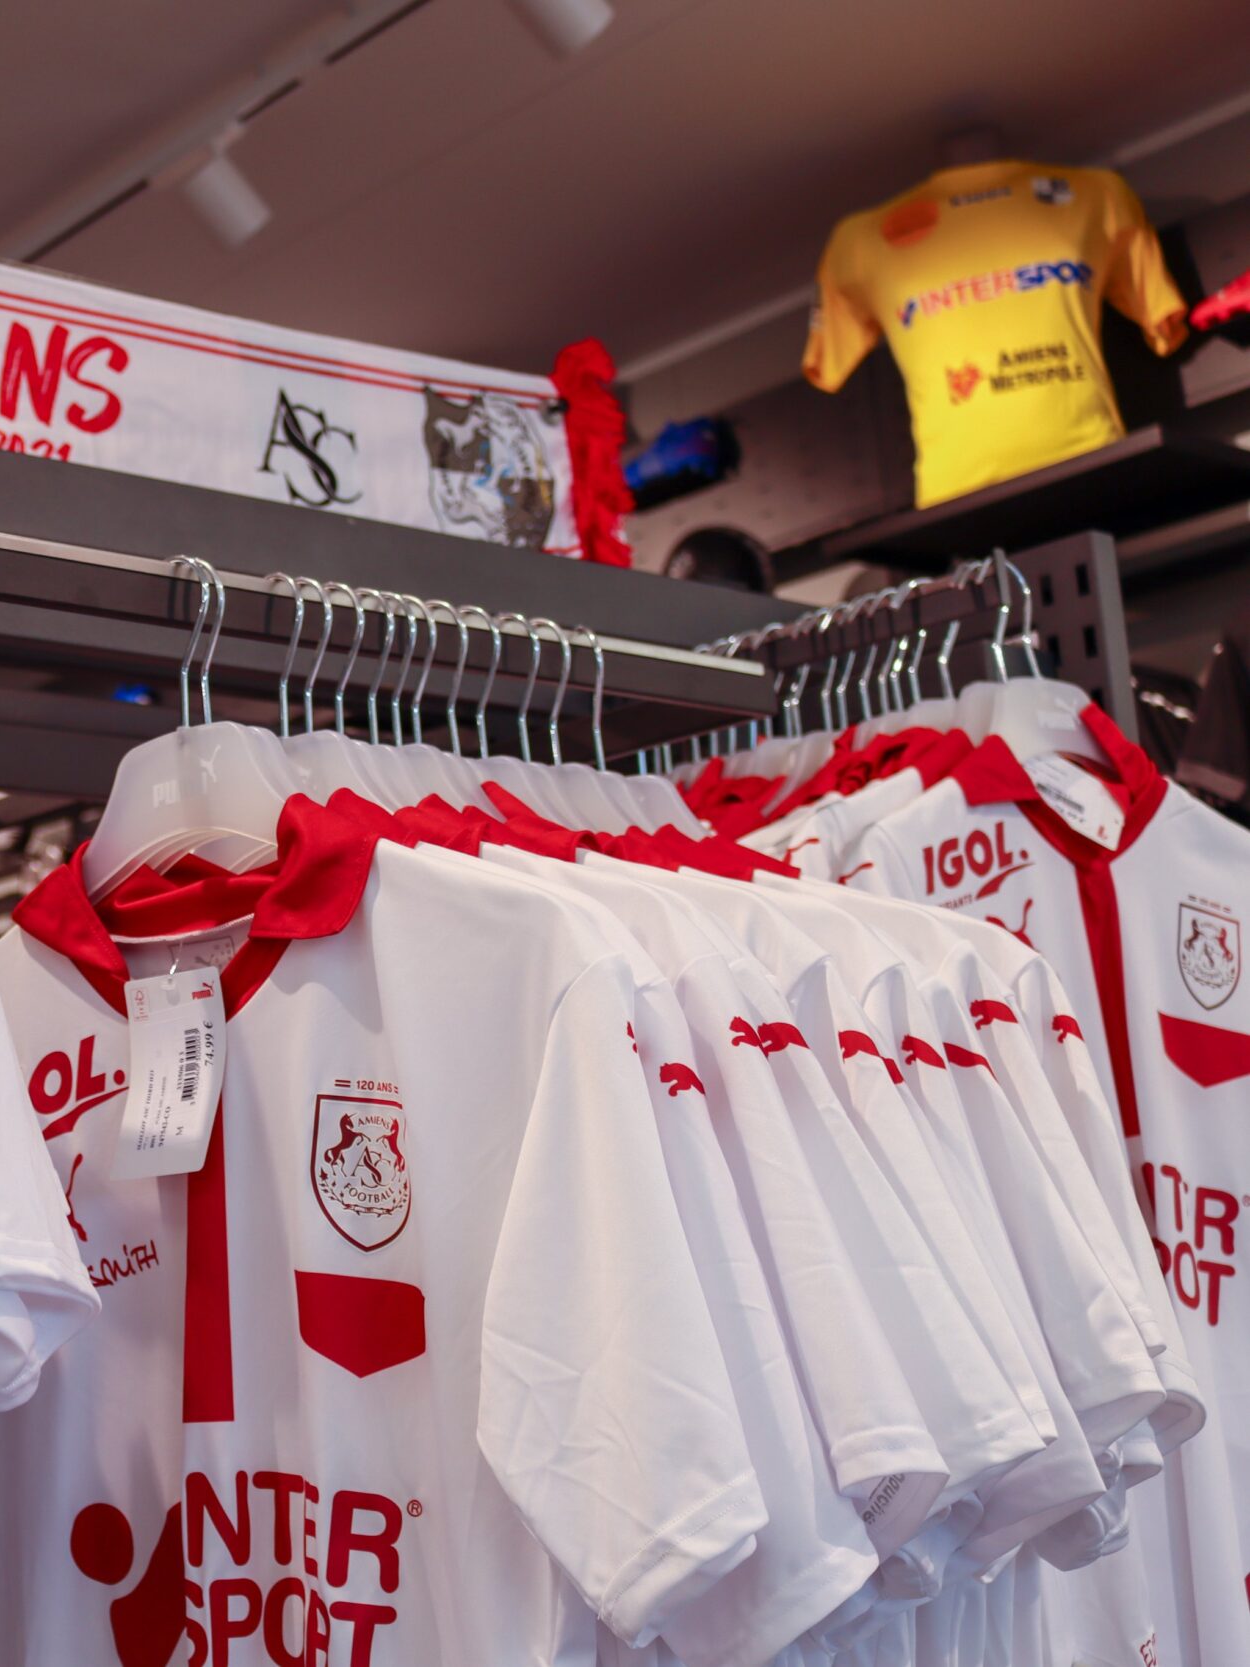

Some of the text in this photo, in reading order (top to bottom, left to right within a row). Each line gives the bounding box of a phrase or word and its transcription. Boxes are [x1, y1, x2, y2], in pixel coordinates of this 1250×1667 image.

[356, 1080, 393, 1093] 120 ANS
[357, 1116, 391, 1130] AMIENS
[344, 1183, 396, 1203] FOOTBALL
